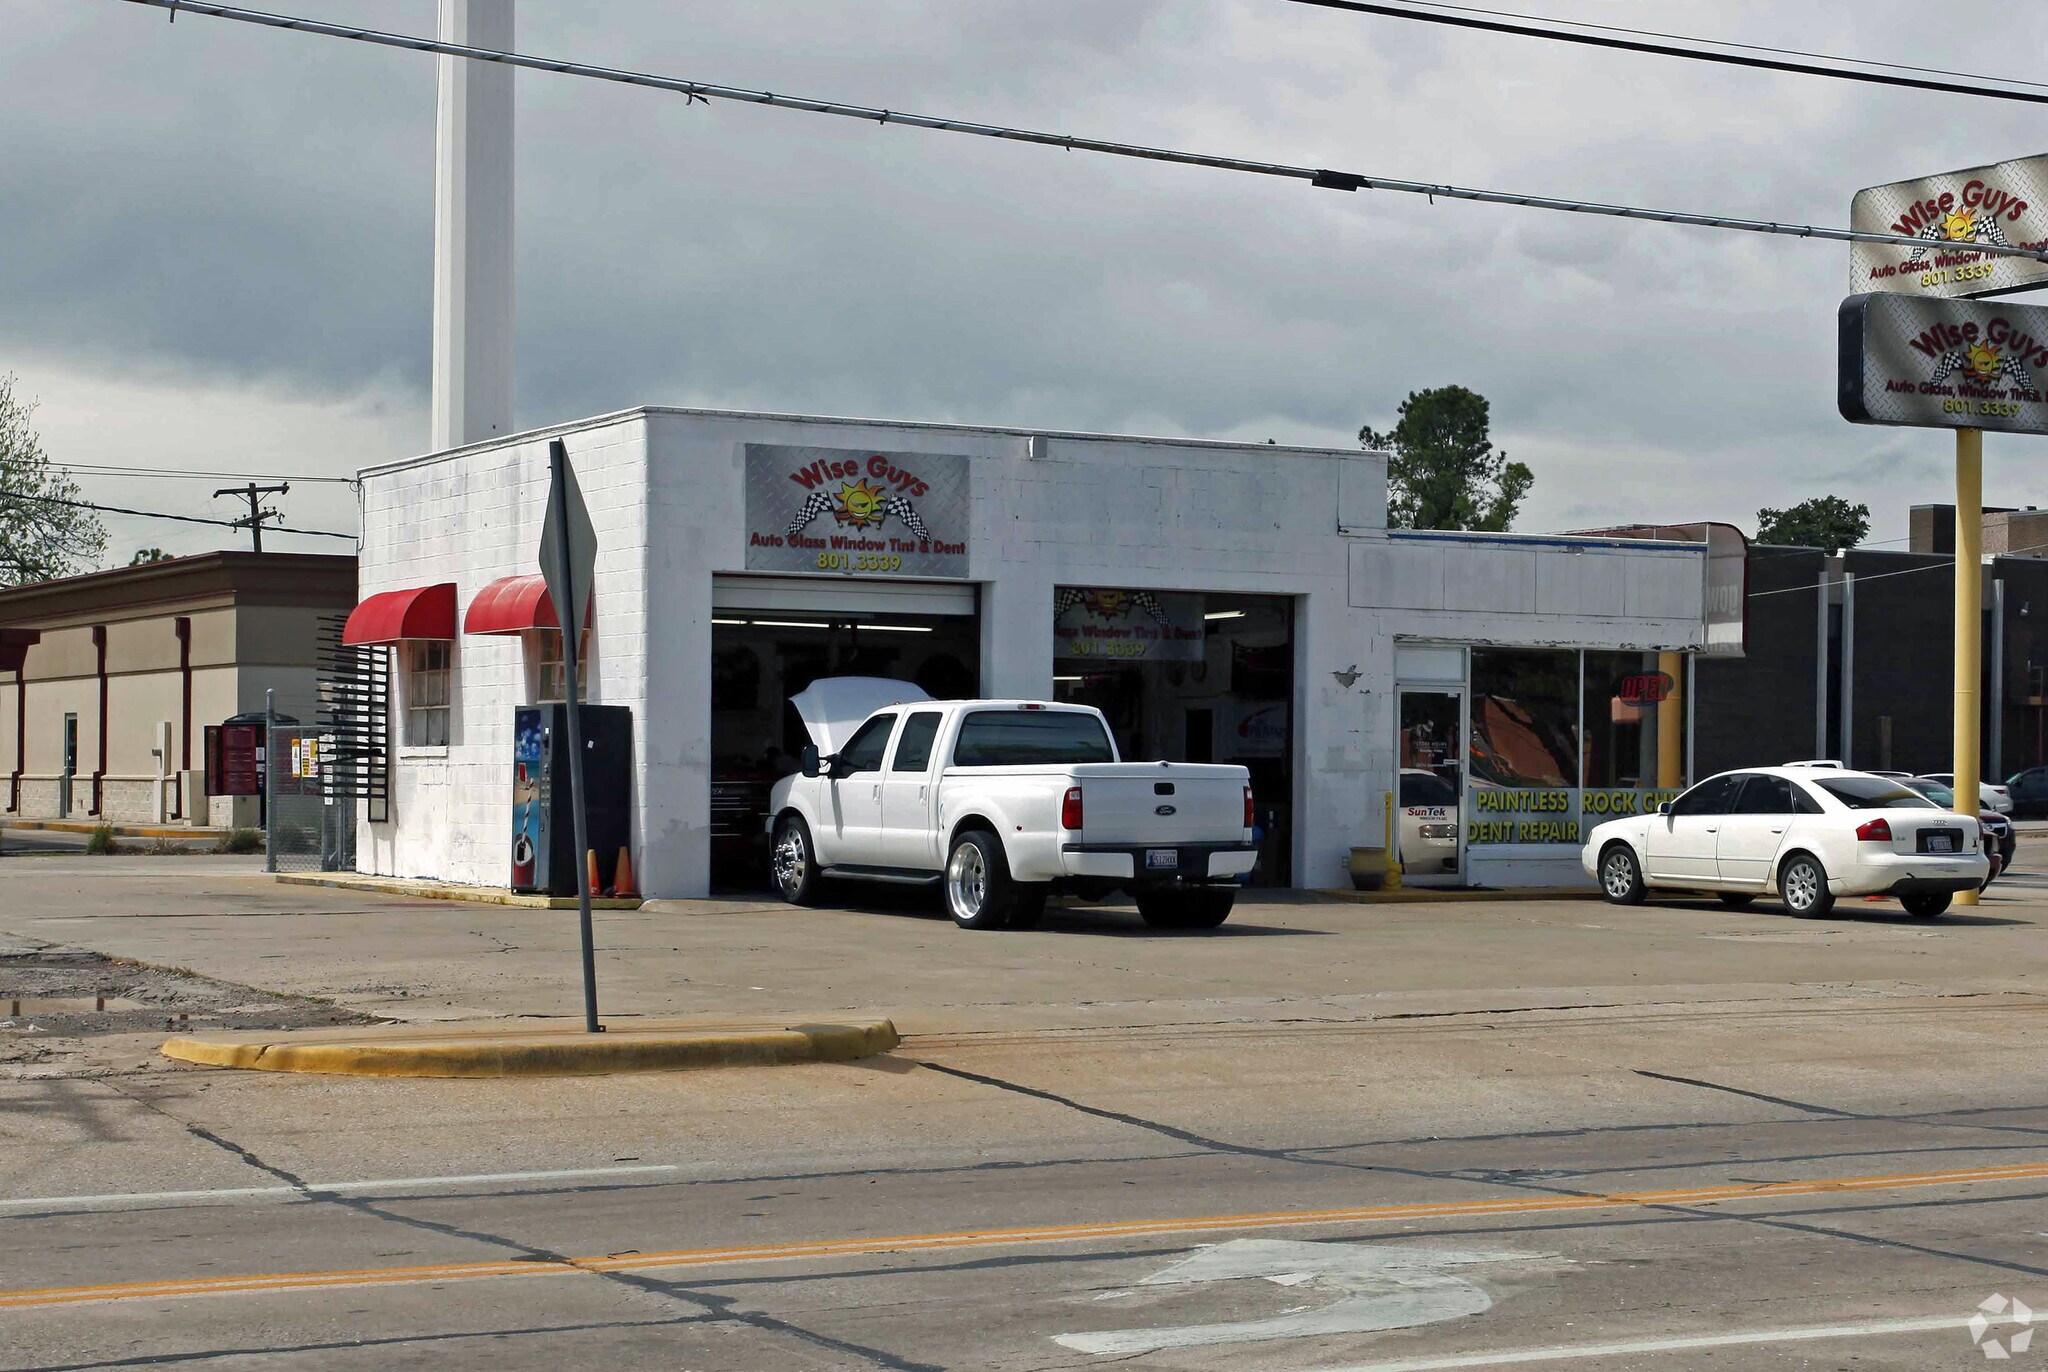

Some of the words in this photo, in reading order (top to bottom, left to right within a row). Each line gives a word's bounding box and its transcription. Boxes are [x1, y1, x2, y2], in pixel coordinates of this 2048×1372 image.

[1891, 191, 1954, 237] Wise
[1962, 180, 2028, 222] Guys
[1870, 264, 1896, 280] Auto
[1935, 252, 1981, 268] Window
[1921, 263, 1993, 287] 801.3339
[1909, 320, 1979, 359] Wise
[1987, 317, 2048, 368] Guys
[1885, 380, 1916, 394] Auto
[1958, 384, 2008, 400] Window
[1943, 399, 2020, 417] 801.3339
[789, 459, 859, 490] Wise
[866, 455, 931, 497] Guys
[750, 532, 783, 547] Auto
[787, 533, 827, 549] Glass
[830, 535, 886, 551] Window
[889, 538, 915, 552] Tint
[918, 540, 929, 554] &
[933, 540, 966, 554] Dent
[817, 552, 901, 571] 801.3339
[1082, 624, 1131, 638] Window
[1621, 674, 1669, 702] OPEN
[1408, 807, 1445, 817] SunTek
[1477, 790, 1569, 813] PAINTLESS
[1582, 791, 1637, 814] ROCK
[1467, 821, 1514, 843] DENT
[1519, 821, 1579, 843] REPAIR
